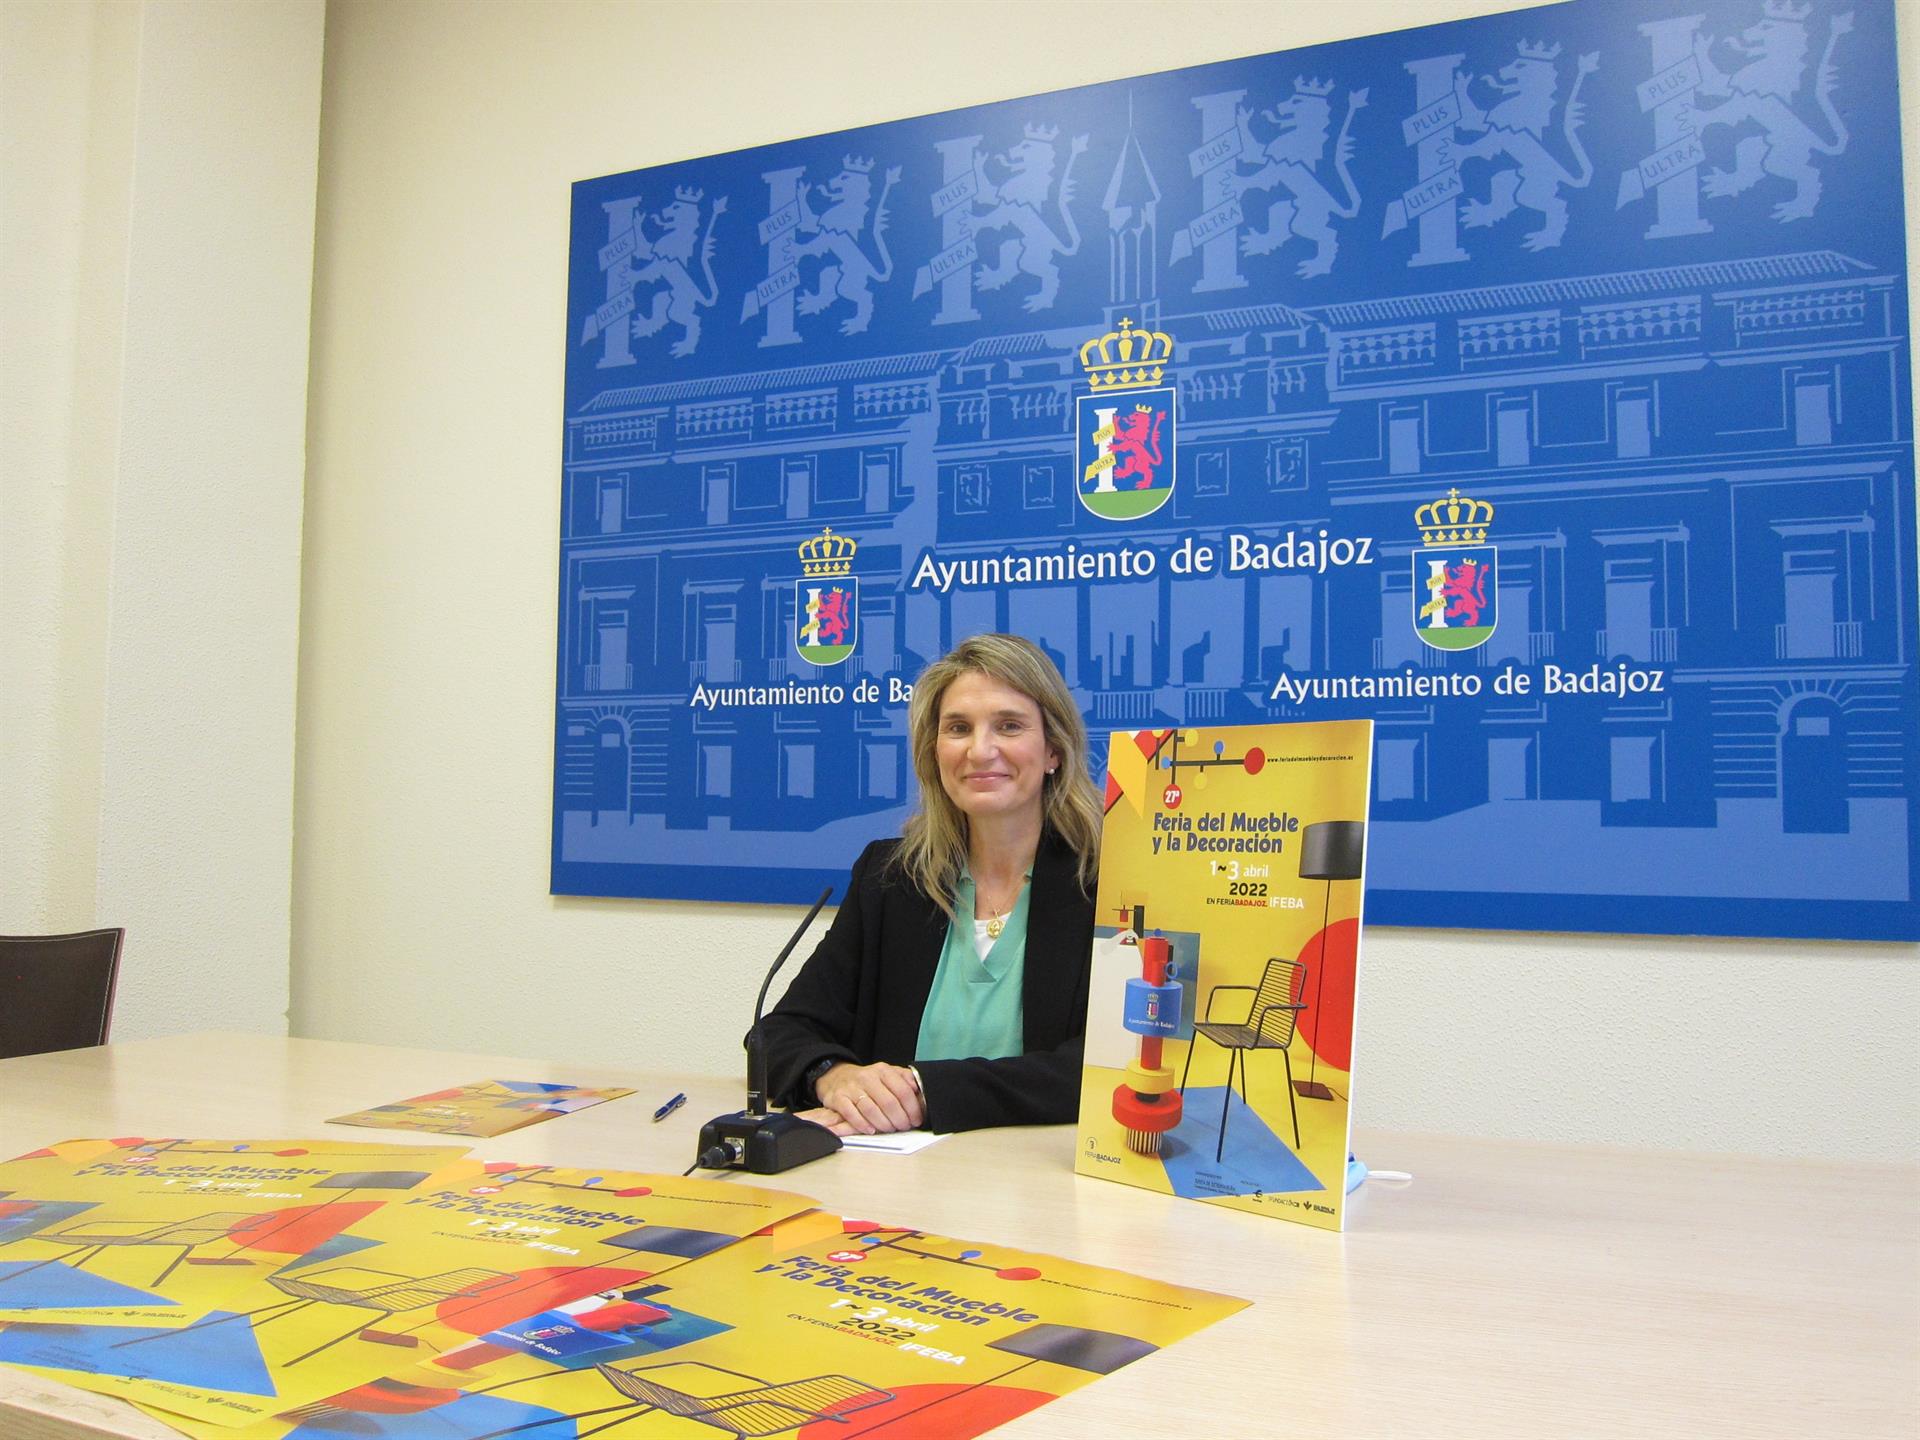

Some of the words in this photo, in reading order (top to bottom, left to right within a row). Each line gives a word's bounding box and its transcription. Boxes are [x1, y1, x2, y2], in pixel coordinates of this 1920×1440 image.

[1649, 71, 1687, 98] PLUS
[1412, 106, 1448, 134] PLUS
[1198, 140, 1231, 166] PLUS
[1644, 144, 1700, 178] ULTRA
[939, 182, 968, 206] PLUS
[1407, 177, 1458, 209] ULTRA
[766, 210, 792, 234] PLUS
[1192, 207, 1240, 238] ULTRA
[604, 238, 628, 260] PLUS
[934, 245, 975, 273] ULTRA
[760, 271, 797, 298] ULTRA
[601, 296, 633, 322] ULTRA
[912, 544, 1156, 593] Ayuntamiento
[1169, 538, 1213, 574] de
[1229, 529, 1374, 574] Badajoz
[690, 681, 844, 711] Ayuntamiento
[852, 678, 879, 703] de
[1270, 669, 1481, 704] Ayuntamiento
[1493, 666, 1530, 695] de
[1544, 663, 1665, 698] Badajoz
[1153, 812, 1192, 832] Feria
[1197, 812, 1225, 832] del
[1230, 812, 1299, 833] Mueble
[1152, 836, 1162, 855] y
[1166, 832, 1180, 851] la
[1186, 832, 1283, 853] Decoración
[1243, 864, 1269, 877] abril
[1229, 882, 1268, 896] 2022
[1269, 896, 1304, 909] IFEBA
[89, 1163, 160, 1171] Feria
[221, 1165, 332, 1175] Mueble
[134, 1169, 298, 1180] Decoración
[427, 1200, 457, 1209] la
[456, 1205, 605, 1229] Decoración
[428, 1190, 492, 1206] Feria
[493, 1200, 545, 1210] del
[541, 1204, 646, 1226] Mueble
[475, 1230, 541, 1241] 2022
[515, 1225, 561, 1236] abril
[525, 1241, 581, 1256] IFEBA
[752, 1263, 785, 1273] y
[781, 1268, 814, 1281] la
[814, 1276, 991, 1326] Decoración
[781, 1255, 855, 1277] Feria
[856, 1275, 918, 1291] del
[911, 1286, 1040, 1323] Mueble
[838, 1317, 917, 1341] 2022
[885, 1315, 940, 1333] abril
[786, 1313, 806, 1321] EN
[897, 1341, 968, 1366] IFEBA
